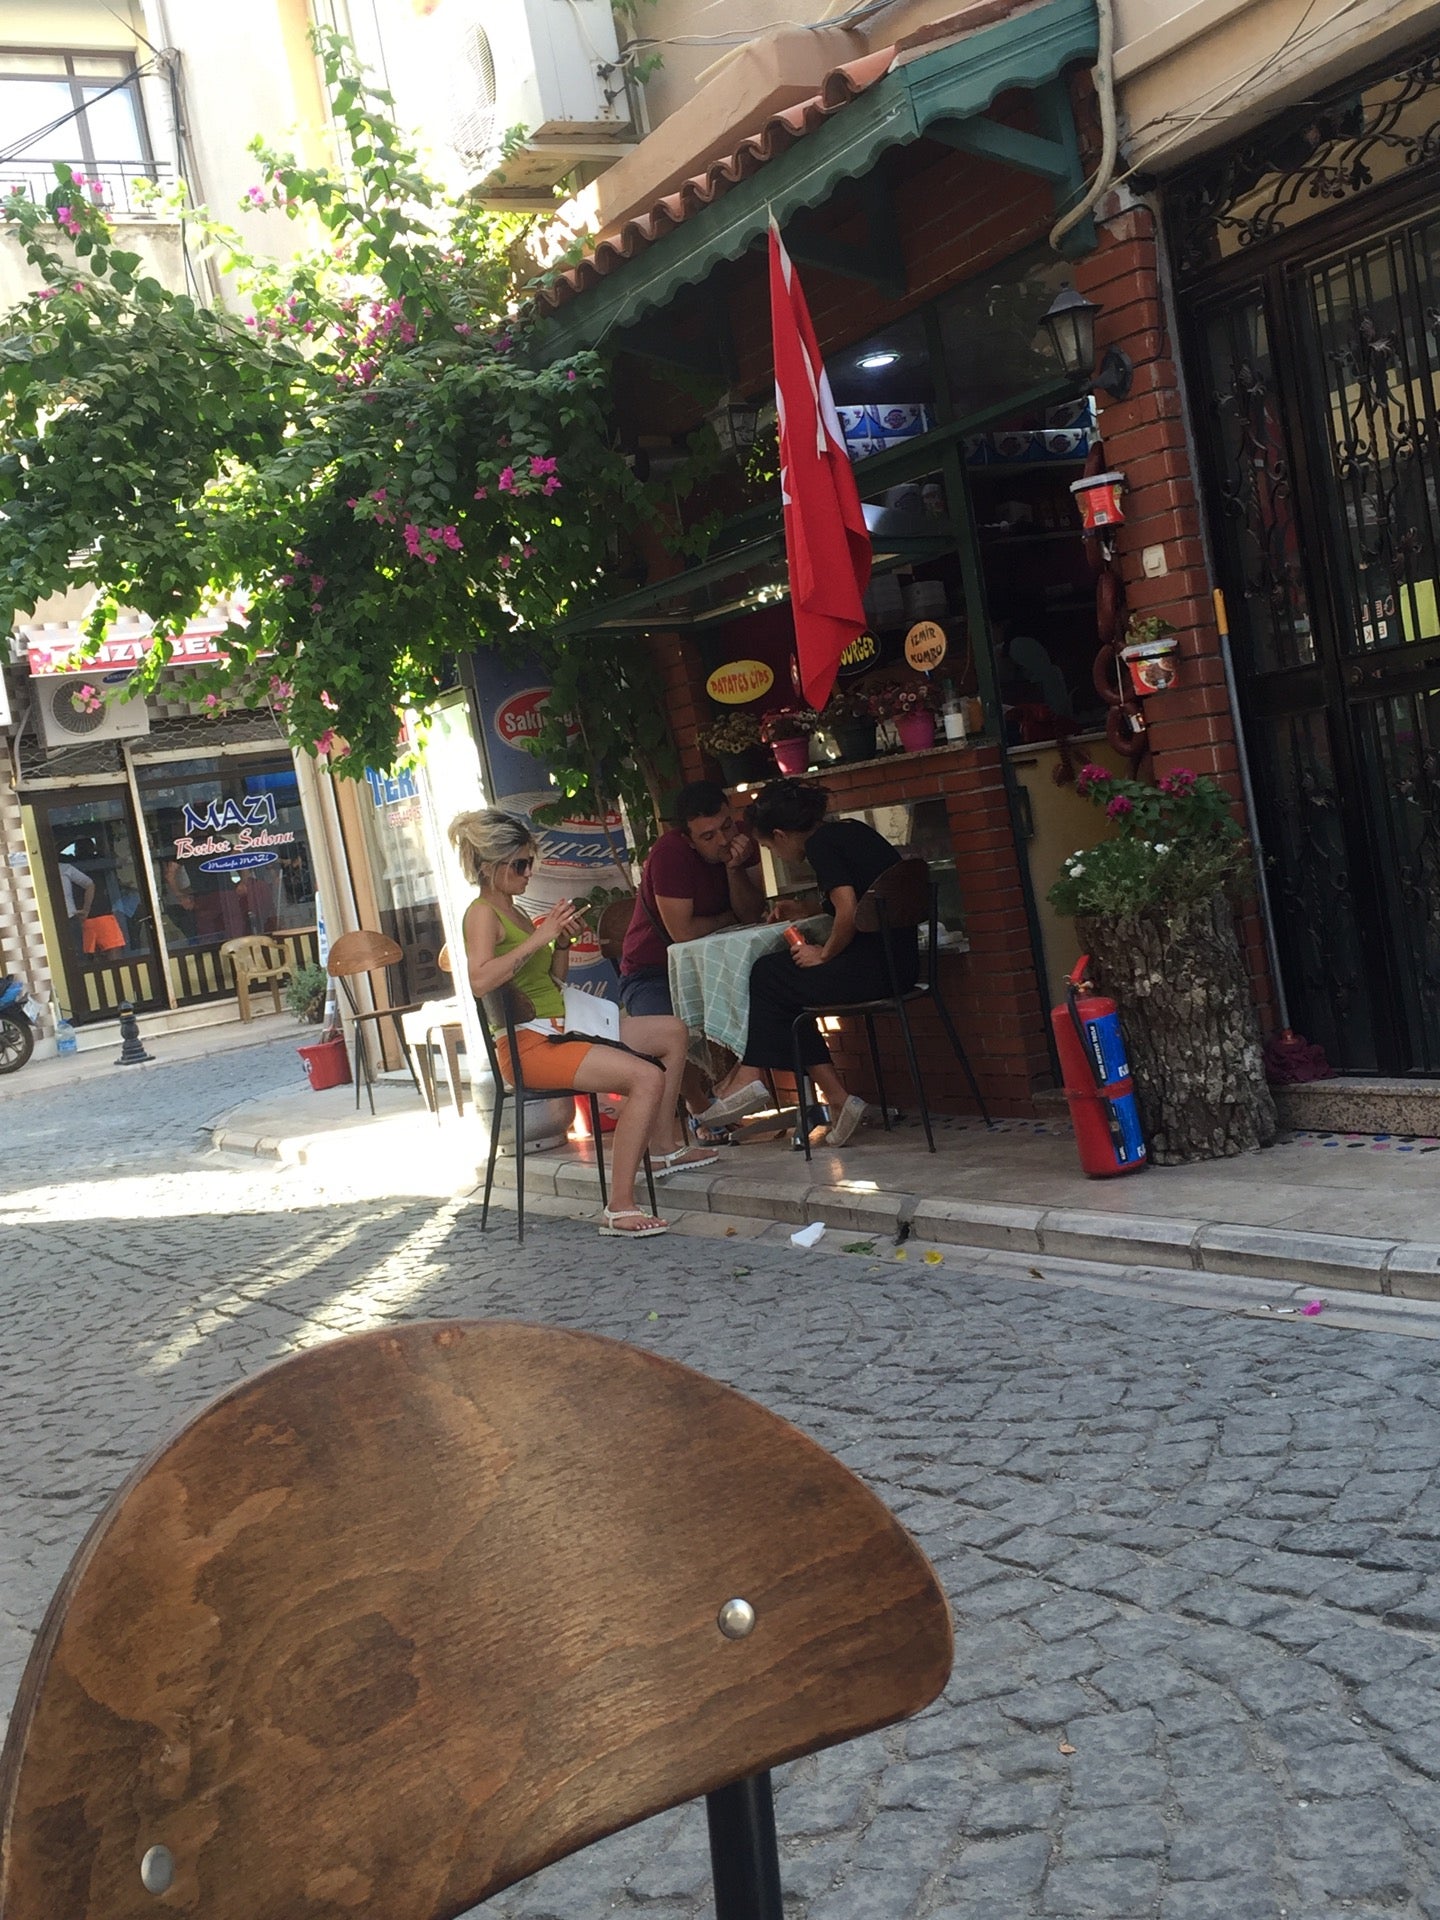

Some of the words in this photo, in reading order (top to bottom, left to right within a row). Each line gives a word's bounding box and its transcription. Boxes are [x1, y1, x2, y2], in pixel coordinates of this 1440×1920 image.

[365, 766, 420, 808] TER
[182, 793, 277, 836] MAZI
[174, 836, 232, 860] Berber
[233, 828, 295, 852] Salonu
[541, 840, 625, 860] yran
